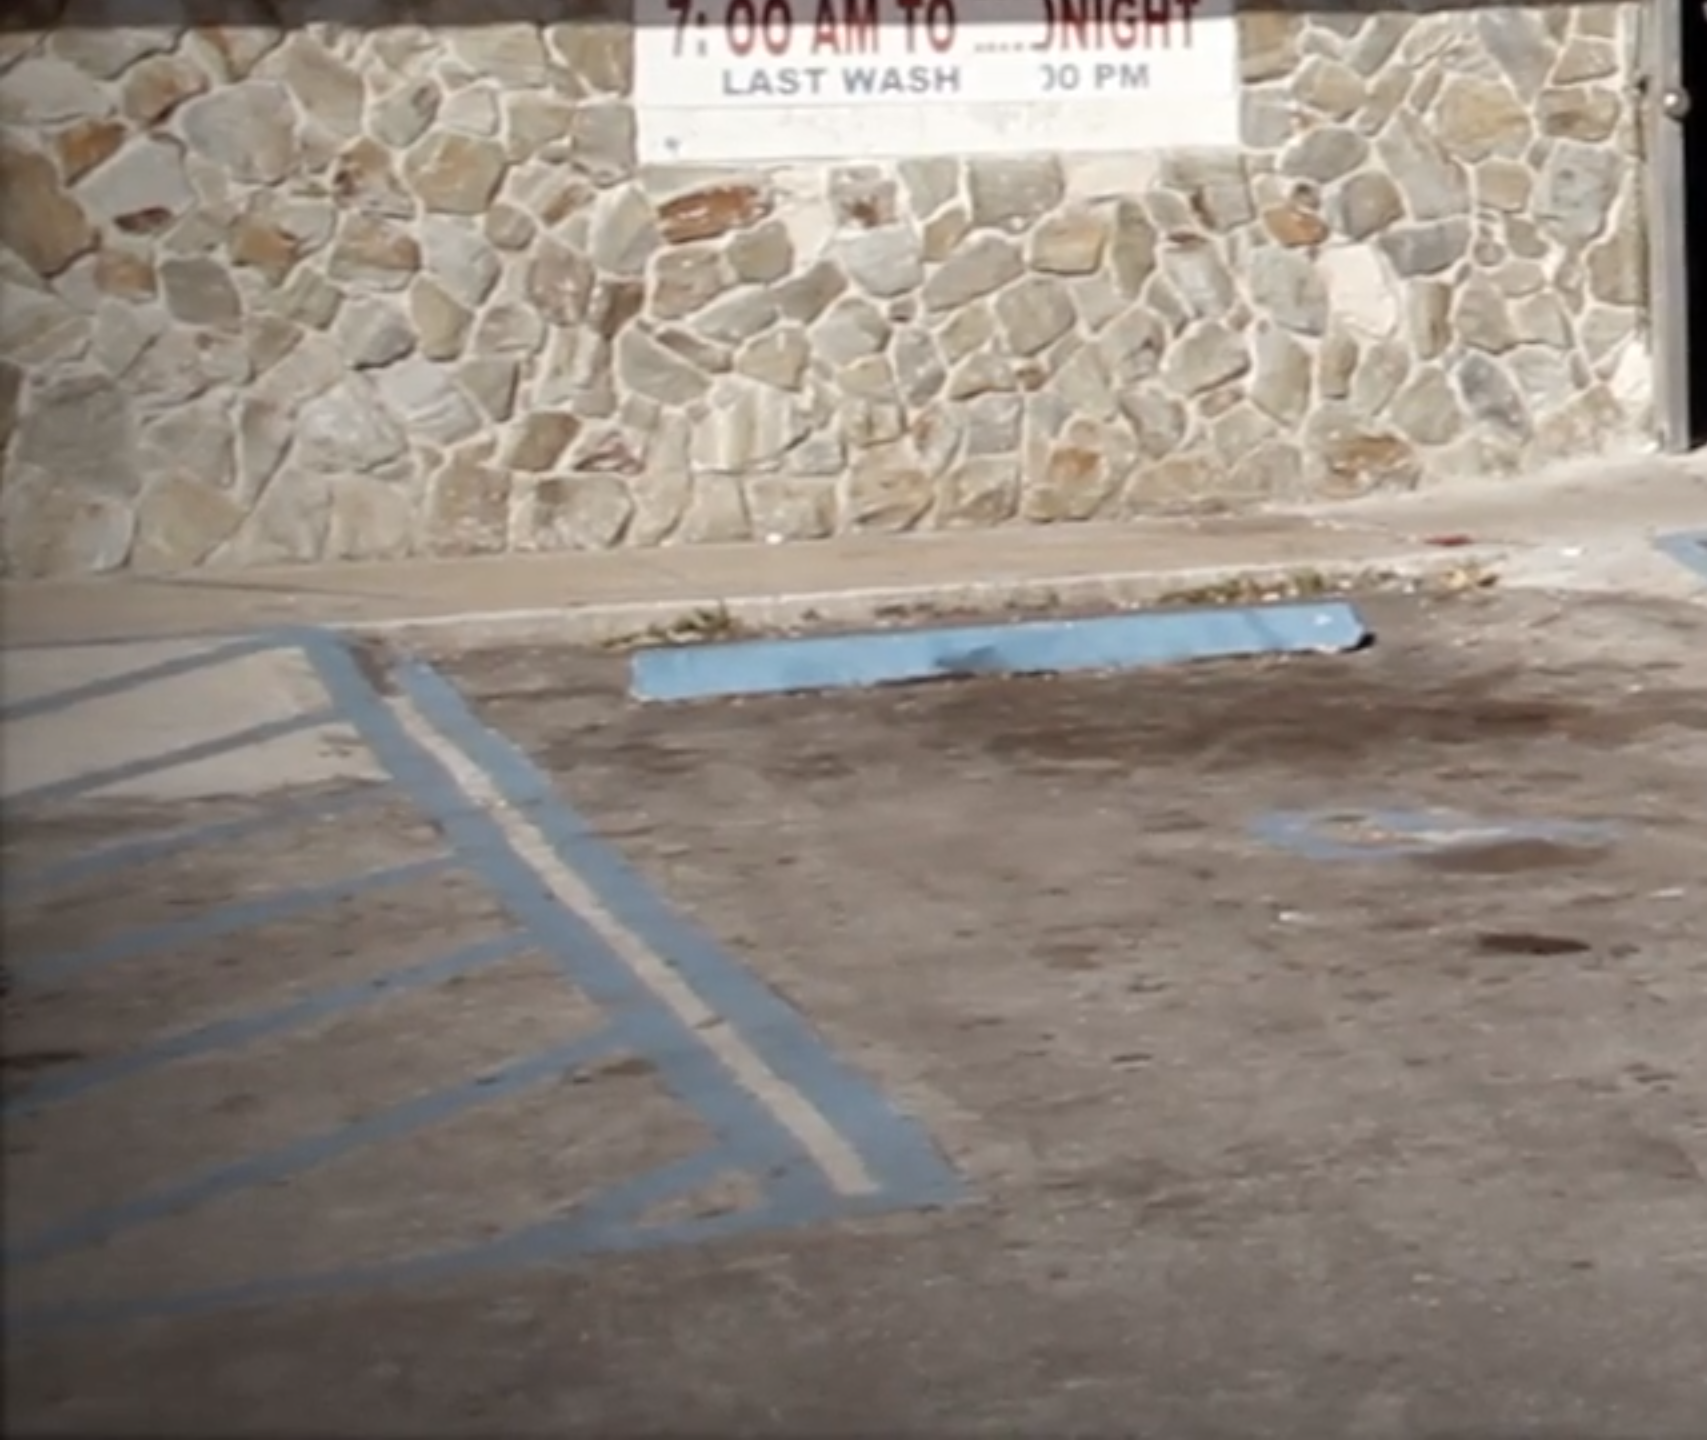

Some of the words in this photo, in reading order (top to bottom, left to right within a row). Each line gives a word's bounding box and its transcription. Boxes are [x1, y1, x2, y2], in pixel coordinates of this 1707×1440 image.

[722, 67, 827, 96] LAST
[842, 66, 961, 93] WASH
[1094, 63, 1150, 90] PM
